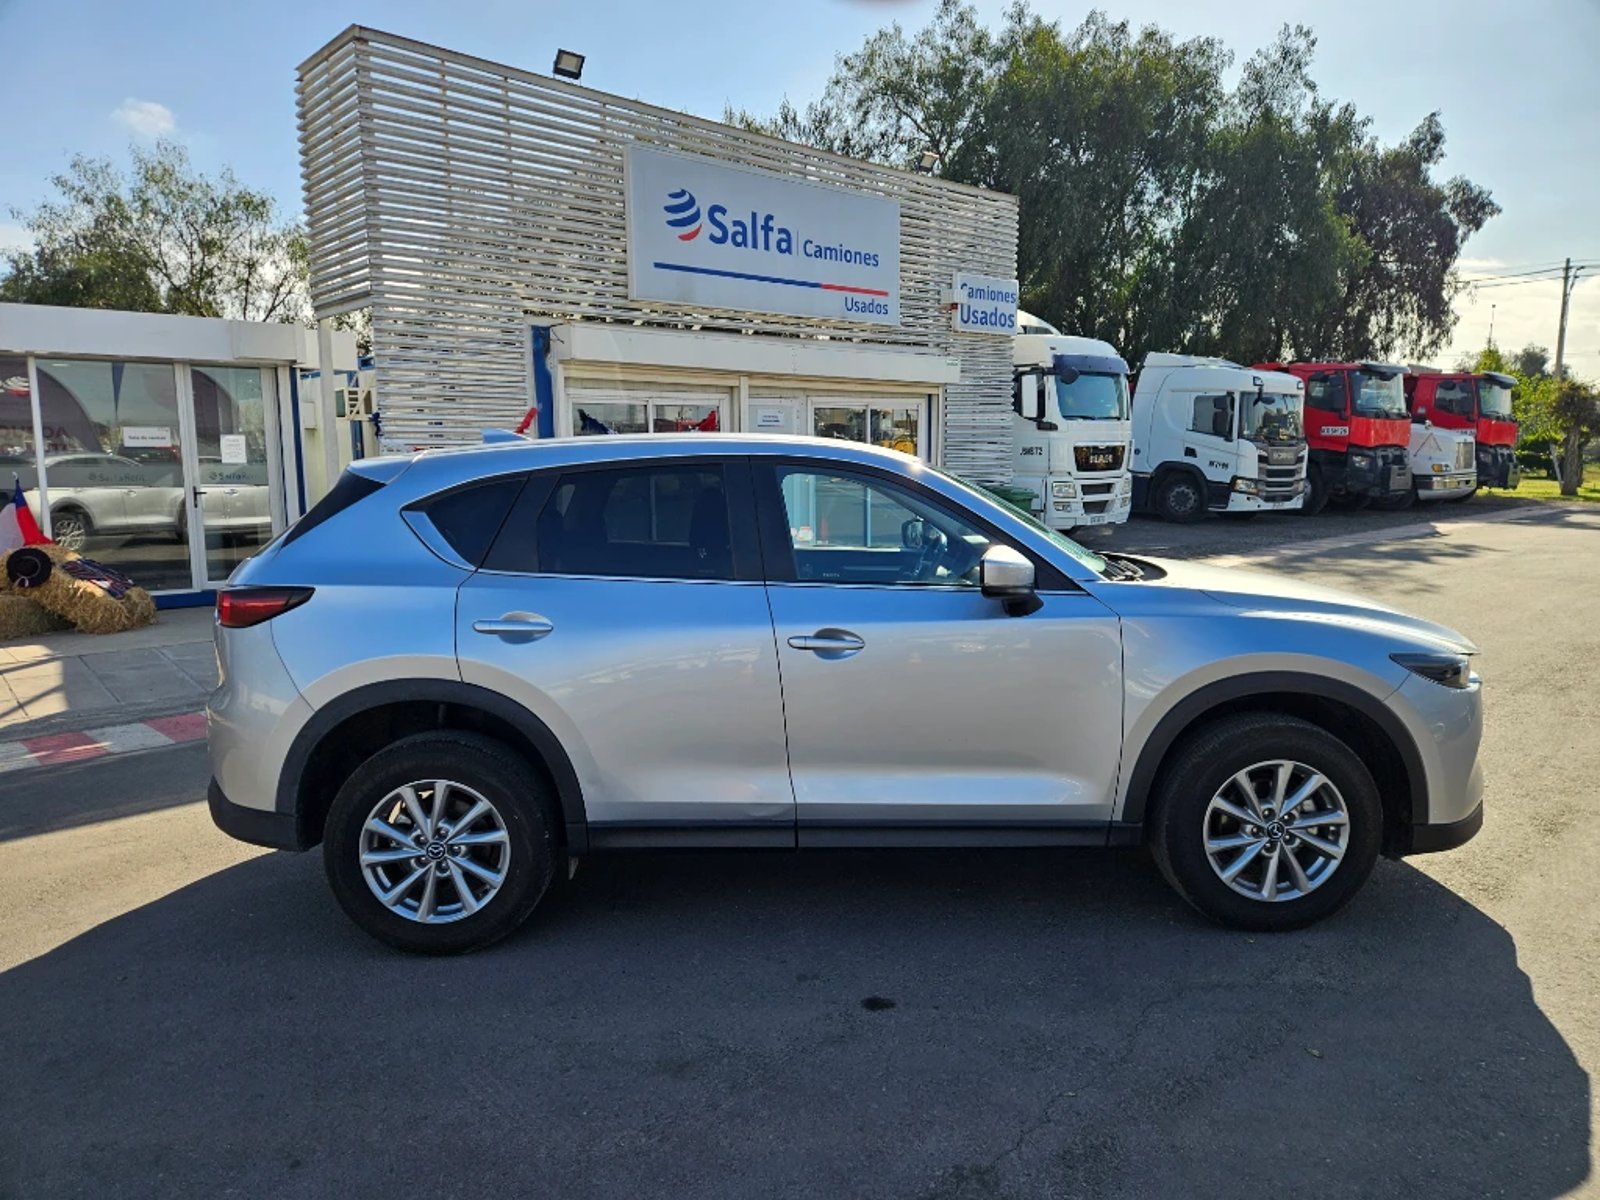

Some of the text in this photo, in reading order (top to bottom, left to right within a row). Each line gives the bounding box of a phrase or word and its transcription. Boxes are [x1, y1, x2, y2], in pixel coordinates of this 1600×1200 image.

[707, 204, 879, 267] Salfa Camiones
[844, 297, 889, 315] Usados
[960, 304, 1015, 328] Usados
